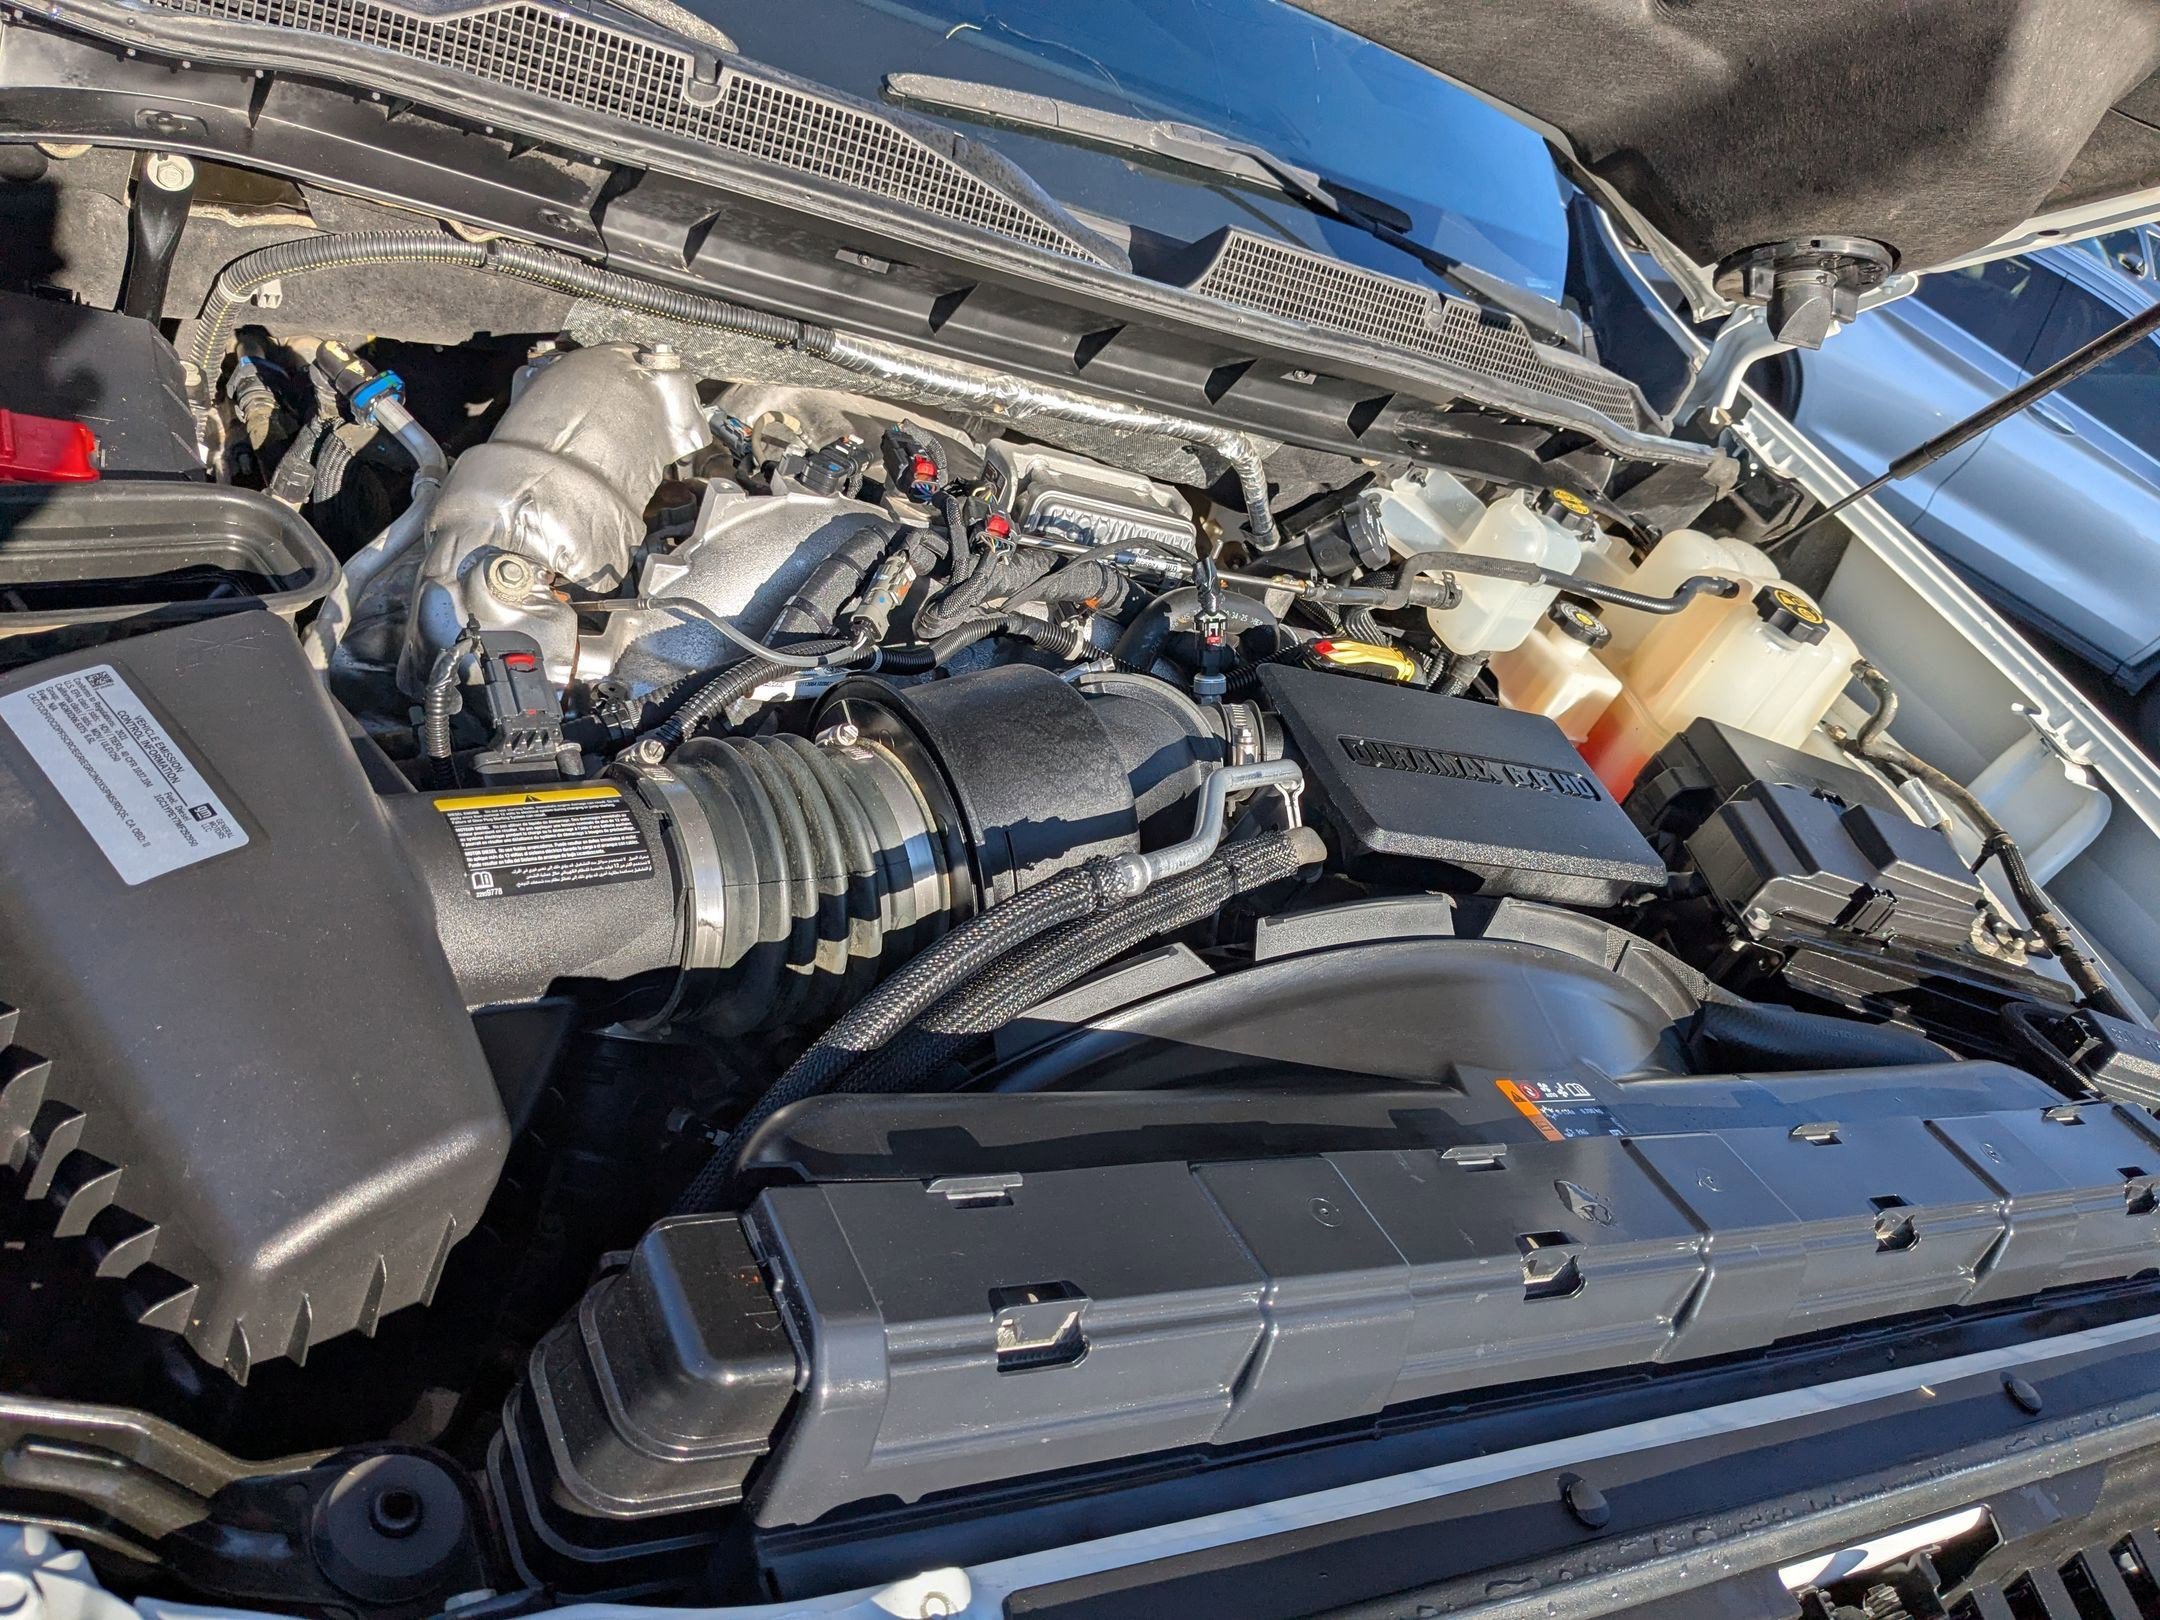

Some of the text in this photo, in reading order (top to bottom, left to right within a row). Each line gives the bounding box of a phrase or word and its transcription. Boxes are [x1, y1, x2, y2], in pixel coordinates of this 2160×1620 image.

[116, 709, 180, 783] CONTROL INFORMATION
[133, 715, 184, 773] VEHICLE EMISSION
[1343, 740, 1502, 784] DURAMAX
[1551, 773, 1601, 801] HD
[174, 805, 191, 822] Diesel
